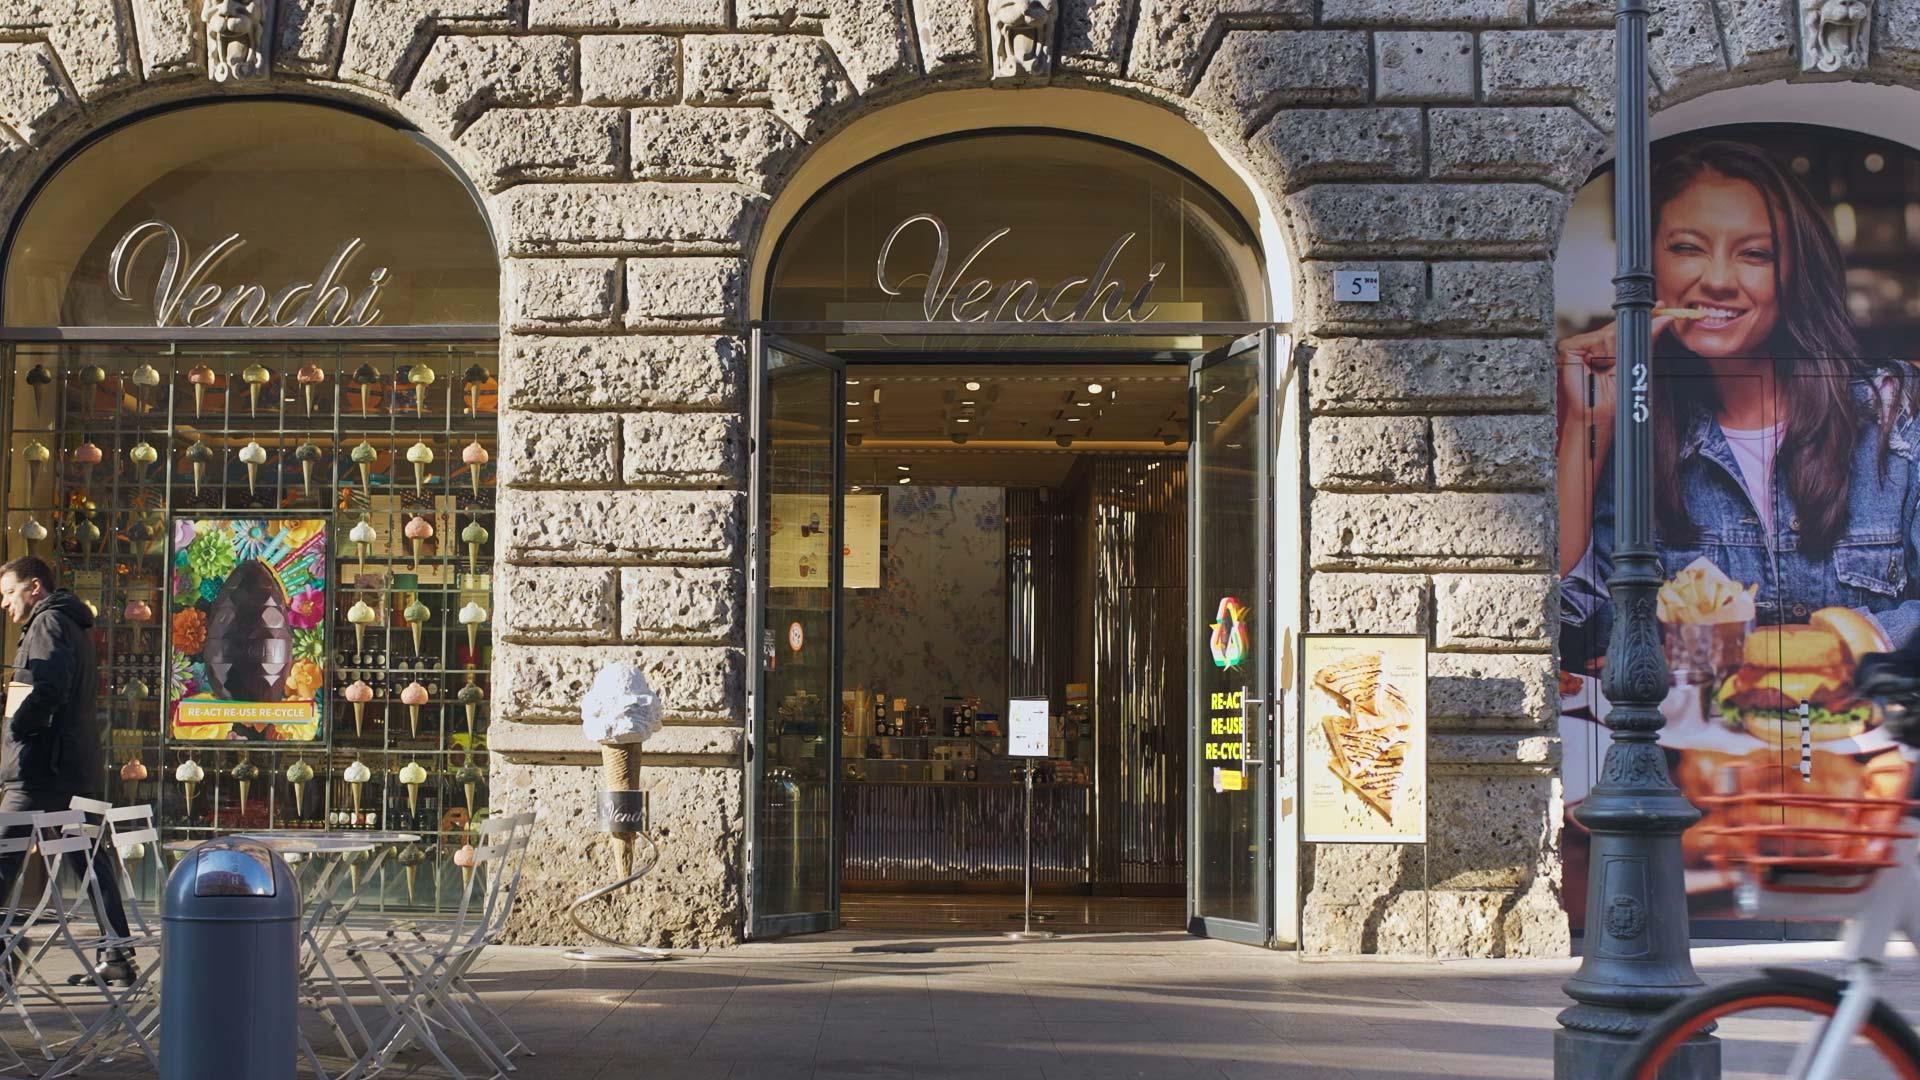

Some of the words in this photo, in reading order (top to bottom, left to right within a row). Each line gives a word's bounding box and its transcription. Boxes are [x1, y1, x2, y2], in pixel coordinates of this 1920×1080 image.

[108, 218, 388, 328] Venchi
[877, 213, 1165, 323] Venchi
[1631, 363, 1649, 423] 25
[188, 707, 222, 717] RE-ACT
[223, 707, 257, 717] RE-USE
[259, 707, 305, 718] RE-CYCLE
